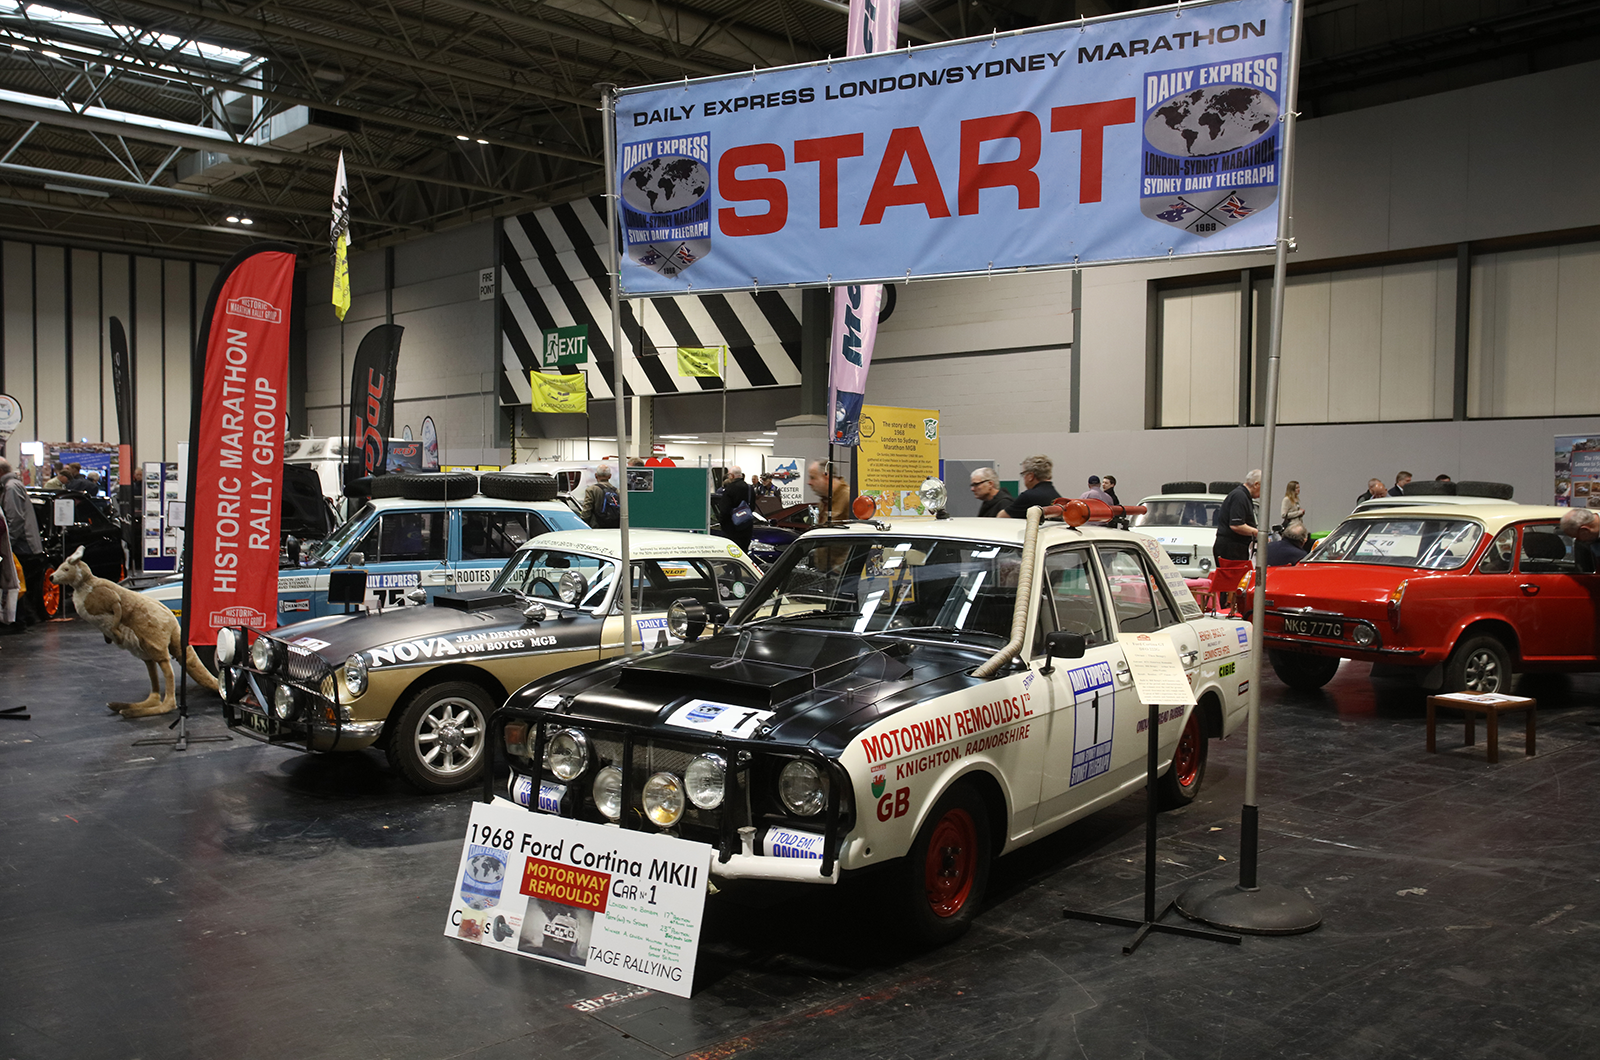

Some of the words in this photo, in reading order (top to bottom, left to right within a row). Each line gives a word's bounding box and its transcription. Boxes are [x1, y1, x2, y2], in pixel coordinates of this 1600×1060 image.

[633, 104, 695, 126] DAILY
[704, 87, 815, 117] EXPRESS
[825, 50, 1067, 100] LONDON/SYDNEY
[1078, 19, 1266, 64] MARATHON
[1147, 70, 1194, 111] DAILY
[1200, 57, 1278, 92] EXPRESS
[624, 138, 653, 174] DAILY
[657, 134, 709, 164] EXPRESS
[718, 97, 1136, 237] START
[1144, 150, 1220, 177] LONDON-SYDNEY
[1221, 136, 1275, 174] MARATHON
[1144, 175, 1182, 195] SYDNEY
[1185, 172, 1213, 191] DAILY
[1215, 164, 1275, 187] TELEGRAPH
[674, 199, 709, 226] MARATHON
[1195, 222, 1216, 232] 1968
[628, 229, 650, 243] SYDNEY
[651, 228, 669, 241] DAILY
[671, 221, 709, 239] TELEGRAPH
[480, 284, 494, 296] POINT
[482, 272, 493, 283] FIRE
[241, 299, 267, 310] HISTORIC
[558, 336, 586, 355] EXIT
[220, 328, 248, 470] MARATHON
[254, 377, 277, 466] GROUP
[249, 471, 274, 550] RALLY
[213, 476, 241, 593] HISTORIC
[383, 574, 418, 588] EXPRESS
[457, 570, 490, 582] ROOTES
[226, 610, 254, 618] HISTORIC
[373, 590, 405, 608] 75
[638, 620, 661, 634] DAILY
[1285, 618, 1308, 633] NKG
[1310, 622, 1341, 637] 777G
[370, 637, 460, 667] NOVA
[456, 632, 479, 645] JEAN
[480, 628, 537, 641] DENTON
[459, 642, 485, 655] TOM
[487, 639, 526, 652] BOYCE
[530, 635, 558, 648] MGB
[1068, 668, 1087, 692] DAILY
[1085, 662, 1110, 688] EXPRESS
[1219, 662, 1236, 678] CIBIE
[731, 711, 759, 733] 1
[861, 713, 954, 764] MOTORWAY
[958, 697, 1020, 737] REMOULDS
[1092, 690, 1099, 745] 1
[965, 724, 1031, 756] RADNORSHIRE
[877, 786, 910, 823] GB
[776, 832, 799, 846] TOLD
[471, 823, 515, 850] 1968
[520, 834, 564, 862] Ford
[570, 844, 643, 878] Cortina
[648, 858, 698, 889] MKII
[526, 862, 608, 892] MOTORWAY
[528, 879, 600, 907] REMOULDS
[647, 885, 657, 905] 1
[587, 946, 620, 967] TAGE
[623, 957, 682, 982] RALLYING
